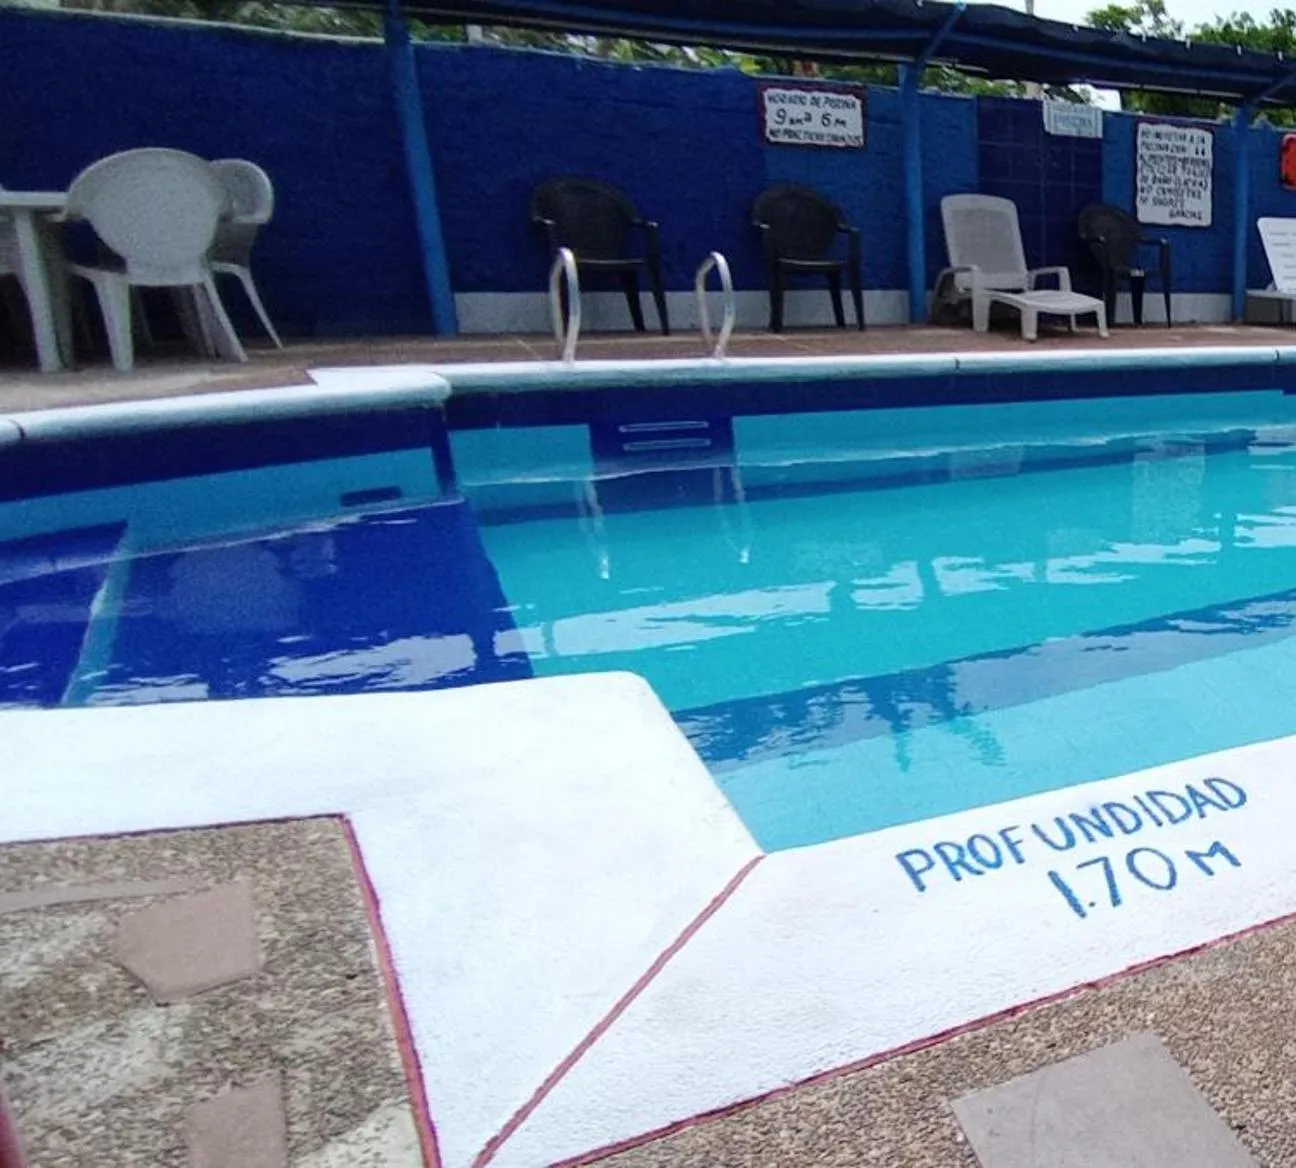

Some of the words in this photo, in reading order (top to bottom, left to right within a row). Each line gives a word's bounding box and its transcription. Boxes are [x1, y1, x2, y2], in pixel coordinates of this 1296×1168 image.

[774, 108, 787, 125] 9
[821, 113, 832, 127] 6
[896, 777, 1247, 893] PROFUNDIDAD
[1047, 847, 1178, 919] 1.70
